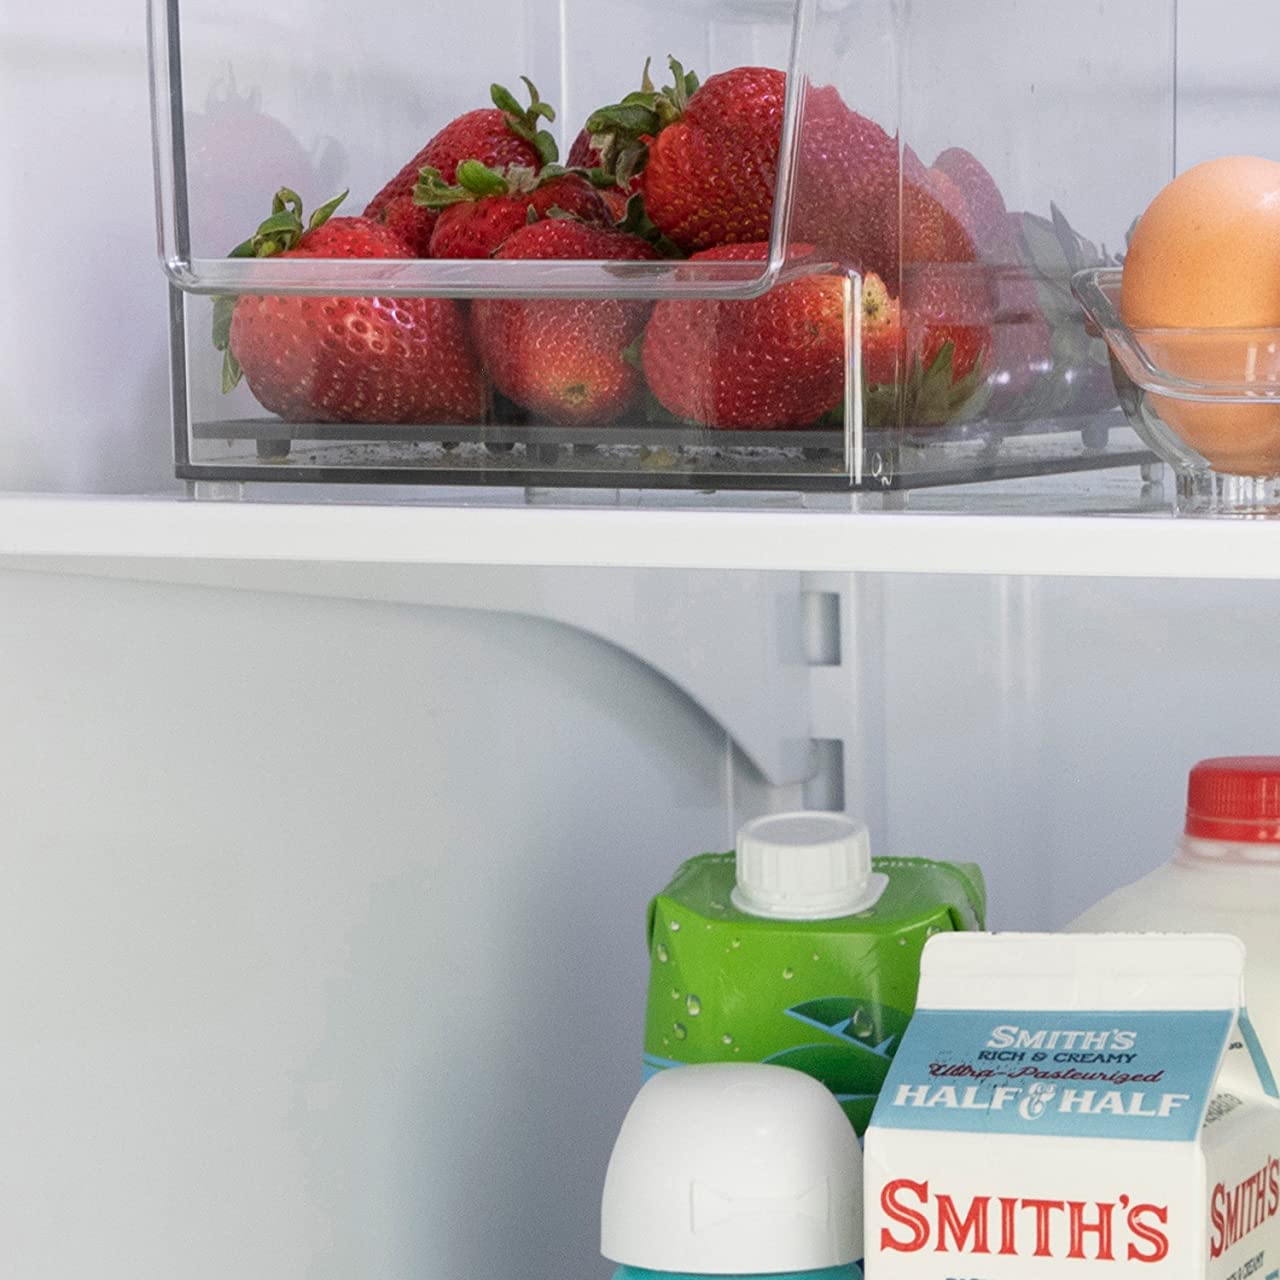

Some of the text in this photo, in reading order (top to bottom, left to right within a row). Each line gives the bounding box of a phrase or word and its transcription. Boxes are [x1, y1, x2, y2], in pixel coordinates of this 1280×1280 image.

[977, 1050, 1025, 1062] RICH
[1053, 1052, 1138, 1064] CREAMY
[986, 1025, 1138, 1051] SMITH'S
[893, 1084, 1023, 1110] HALF
[1019, 1081, 1056, 1121] &
[1058, 1088, 1190, 1117] HALF
[880, 1178, 1169, 1264] SMITH'S
[1209, 1154, 1280, 1262] SMITH'S
